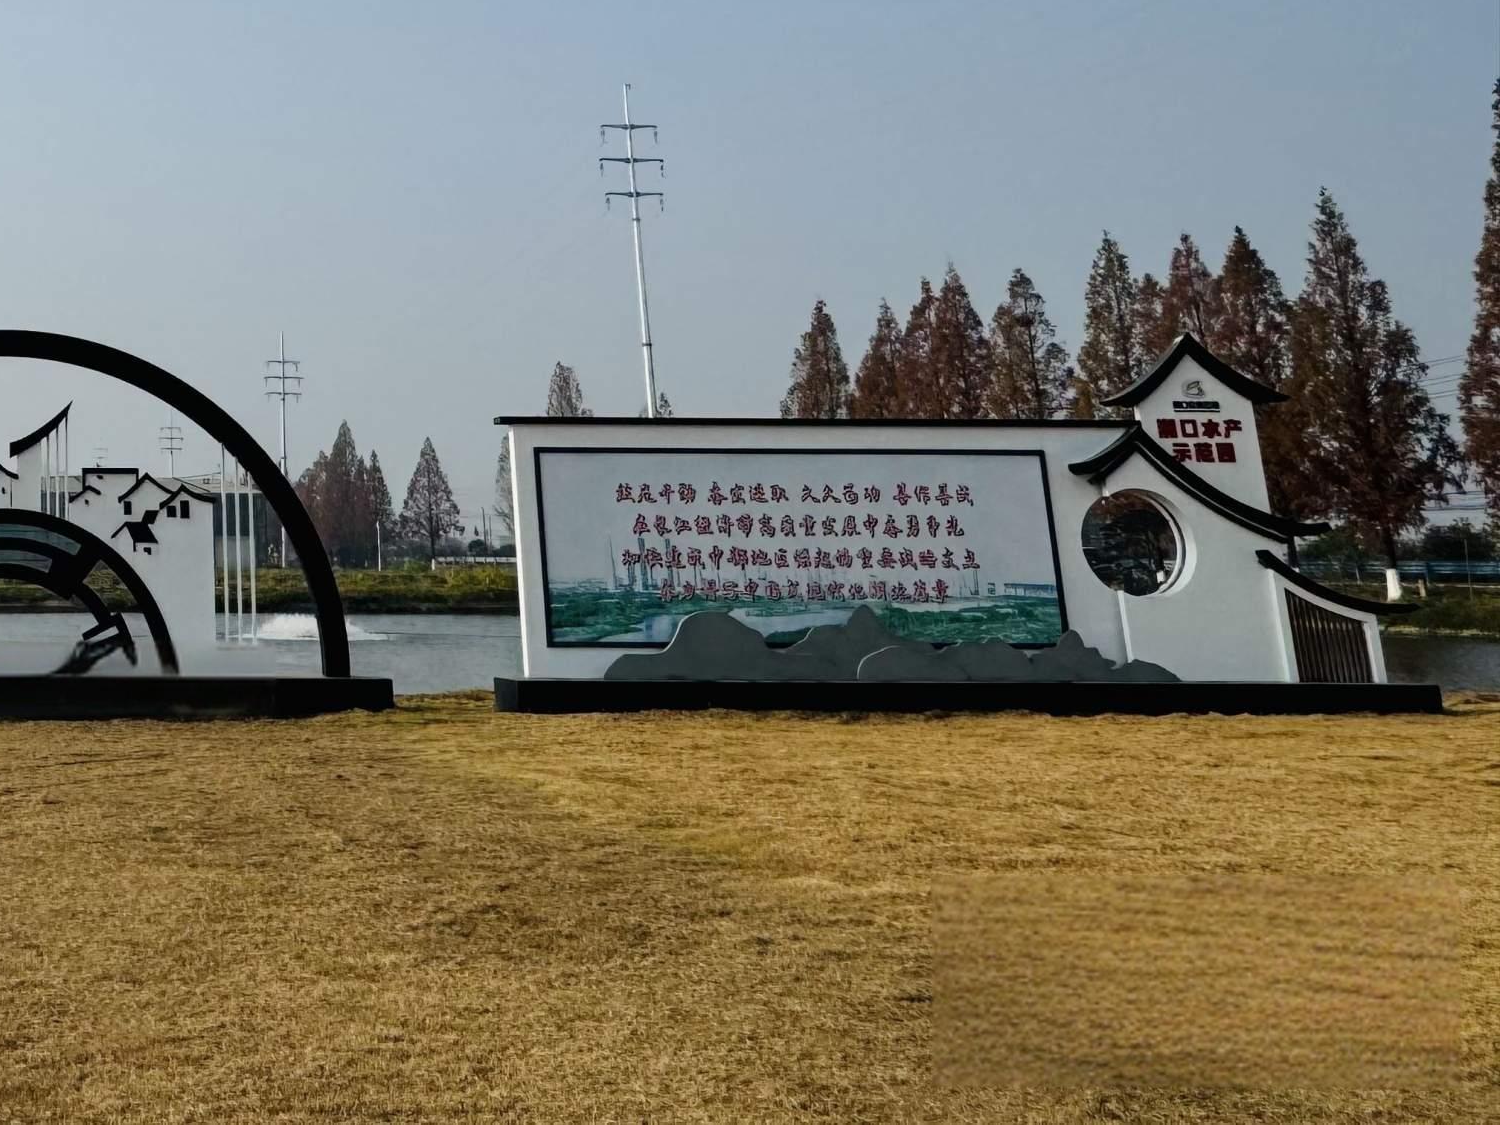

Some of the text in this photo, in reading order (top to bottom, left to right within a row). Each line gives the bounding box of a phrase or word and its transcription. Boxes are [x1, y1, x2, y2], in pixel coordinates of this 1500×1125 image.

[1171, 442, 1237, 463] 示范园
[801, 483, 881, 506] 久久为功
[892, 482, 975, 507] 善作善成
